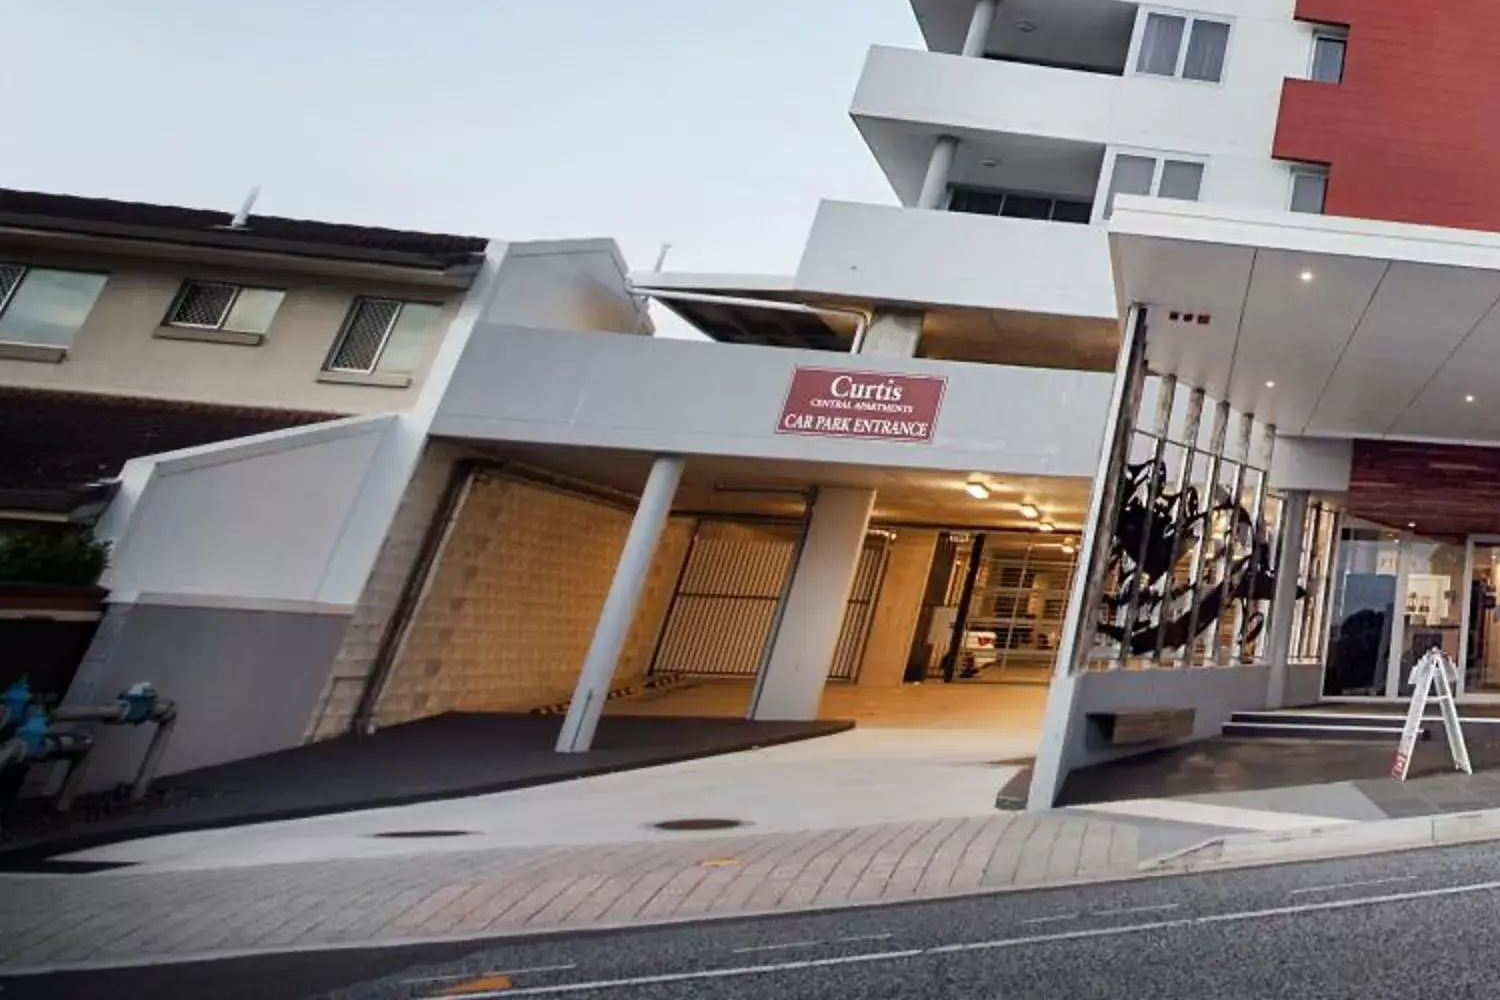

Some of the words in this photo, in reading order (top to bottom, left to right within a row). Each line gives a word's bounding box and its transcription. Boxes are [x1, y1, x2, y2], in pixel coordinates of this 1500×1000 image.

[831, 375, 902, 401] Curtis
[810, 397, 851, 410] CENTRAL
[853, 401, 914, 414] APARTMENTS
[784, 413, 813, 429] CAR
[815, 415, 852, 431] PARK
[853, 419, 928, 437] ENTRANCE
